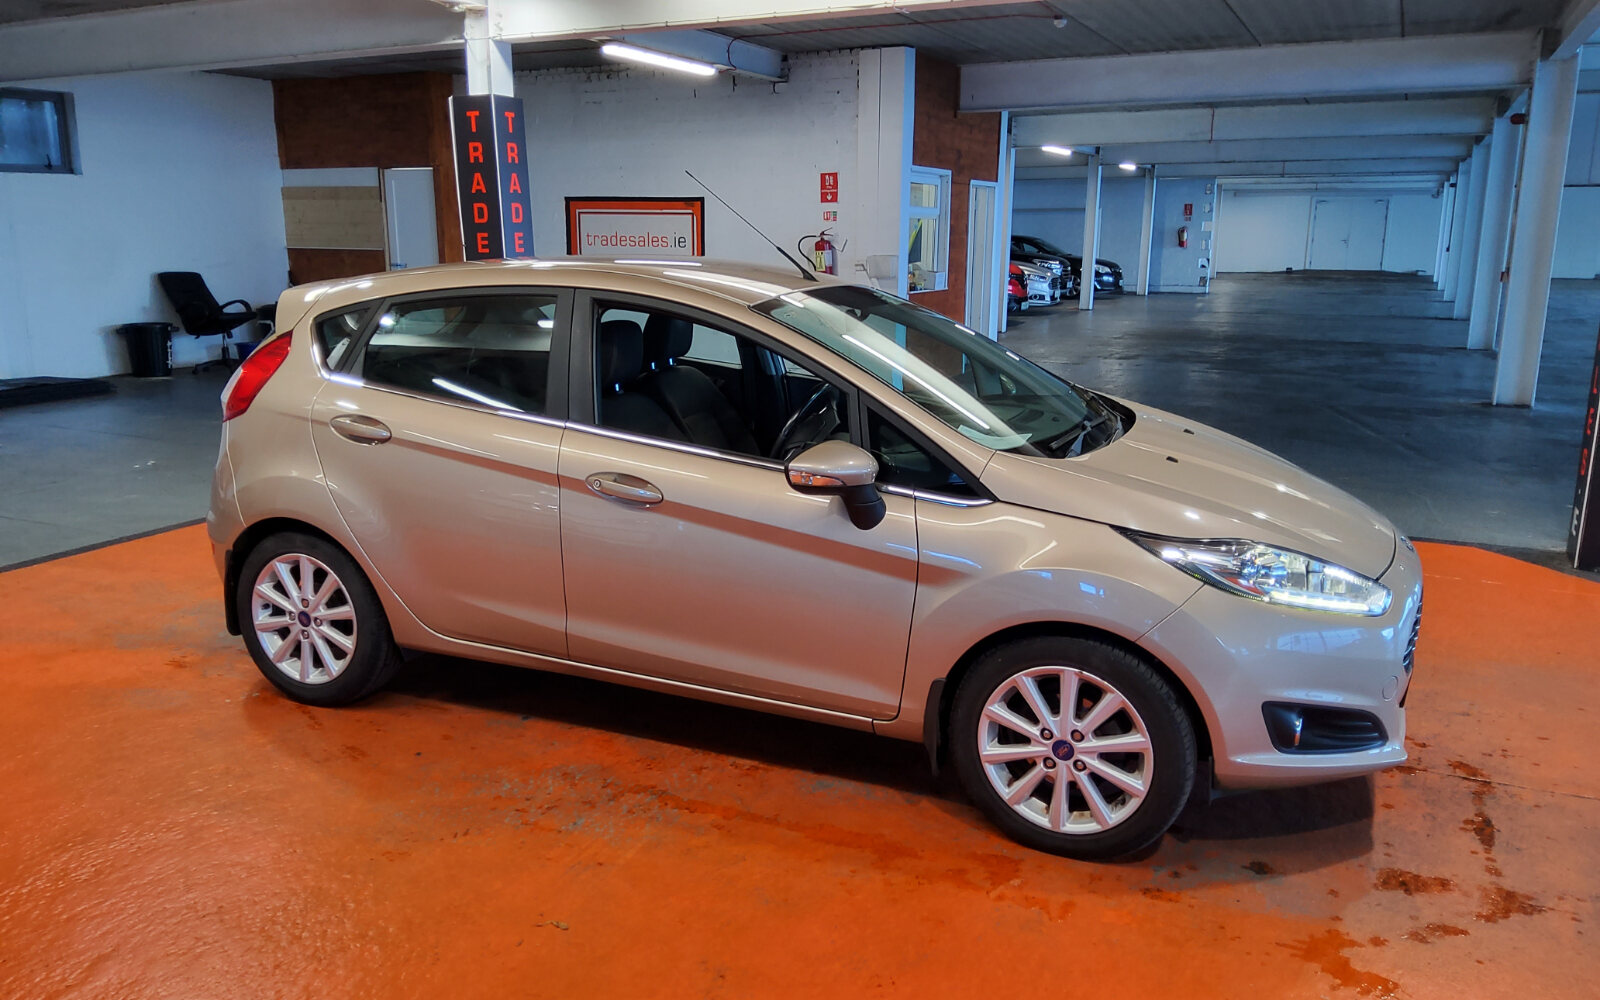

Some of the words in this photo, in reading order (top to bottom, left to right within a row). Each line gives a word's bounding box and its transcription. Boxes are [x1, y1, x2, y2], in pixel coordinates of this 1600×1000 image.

[466, 110, 490, 253] TRADE
[504, 111, 525, 253] TRADE
[586, 230, 687, 249] tradesales.ie
